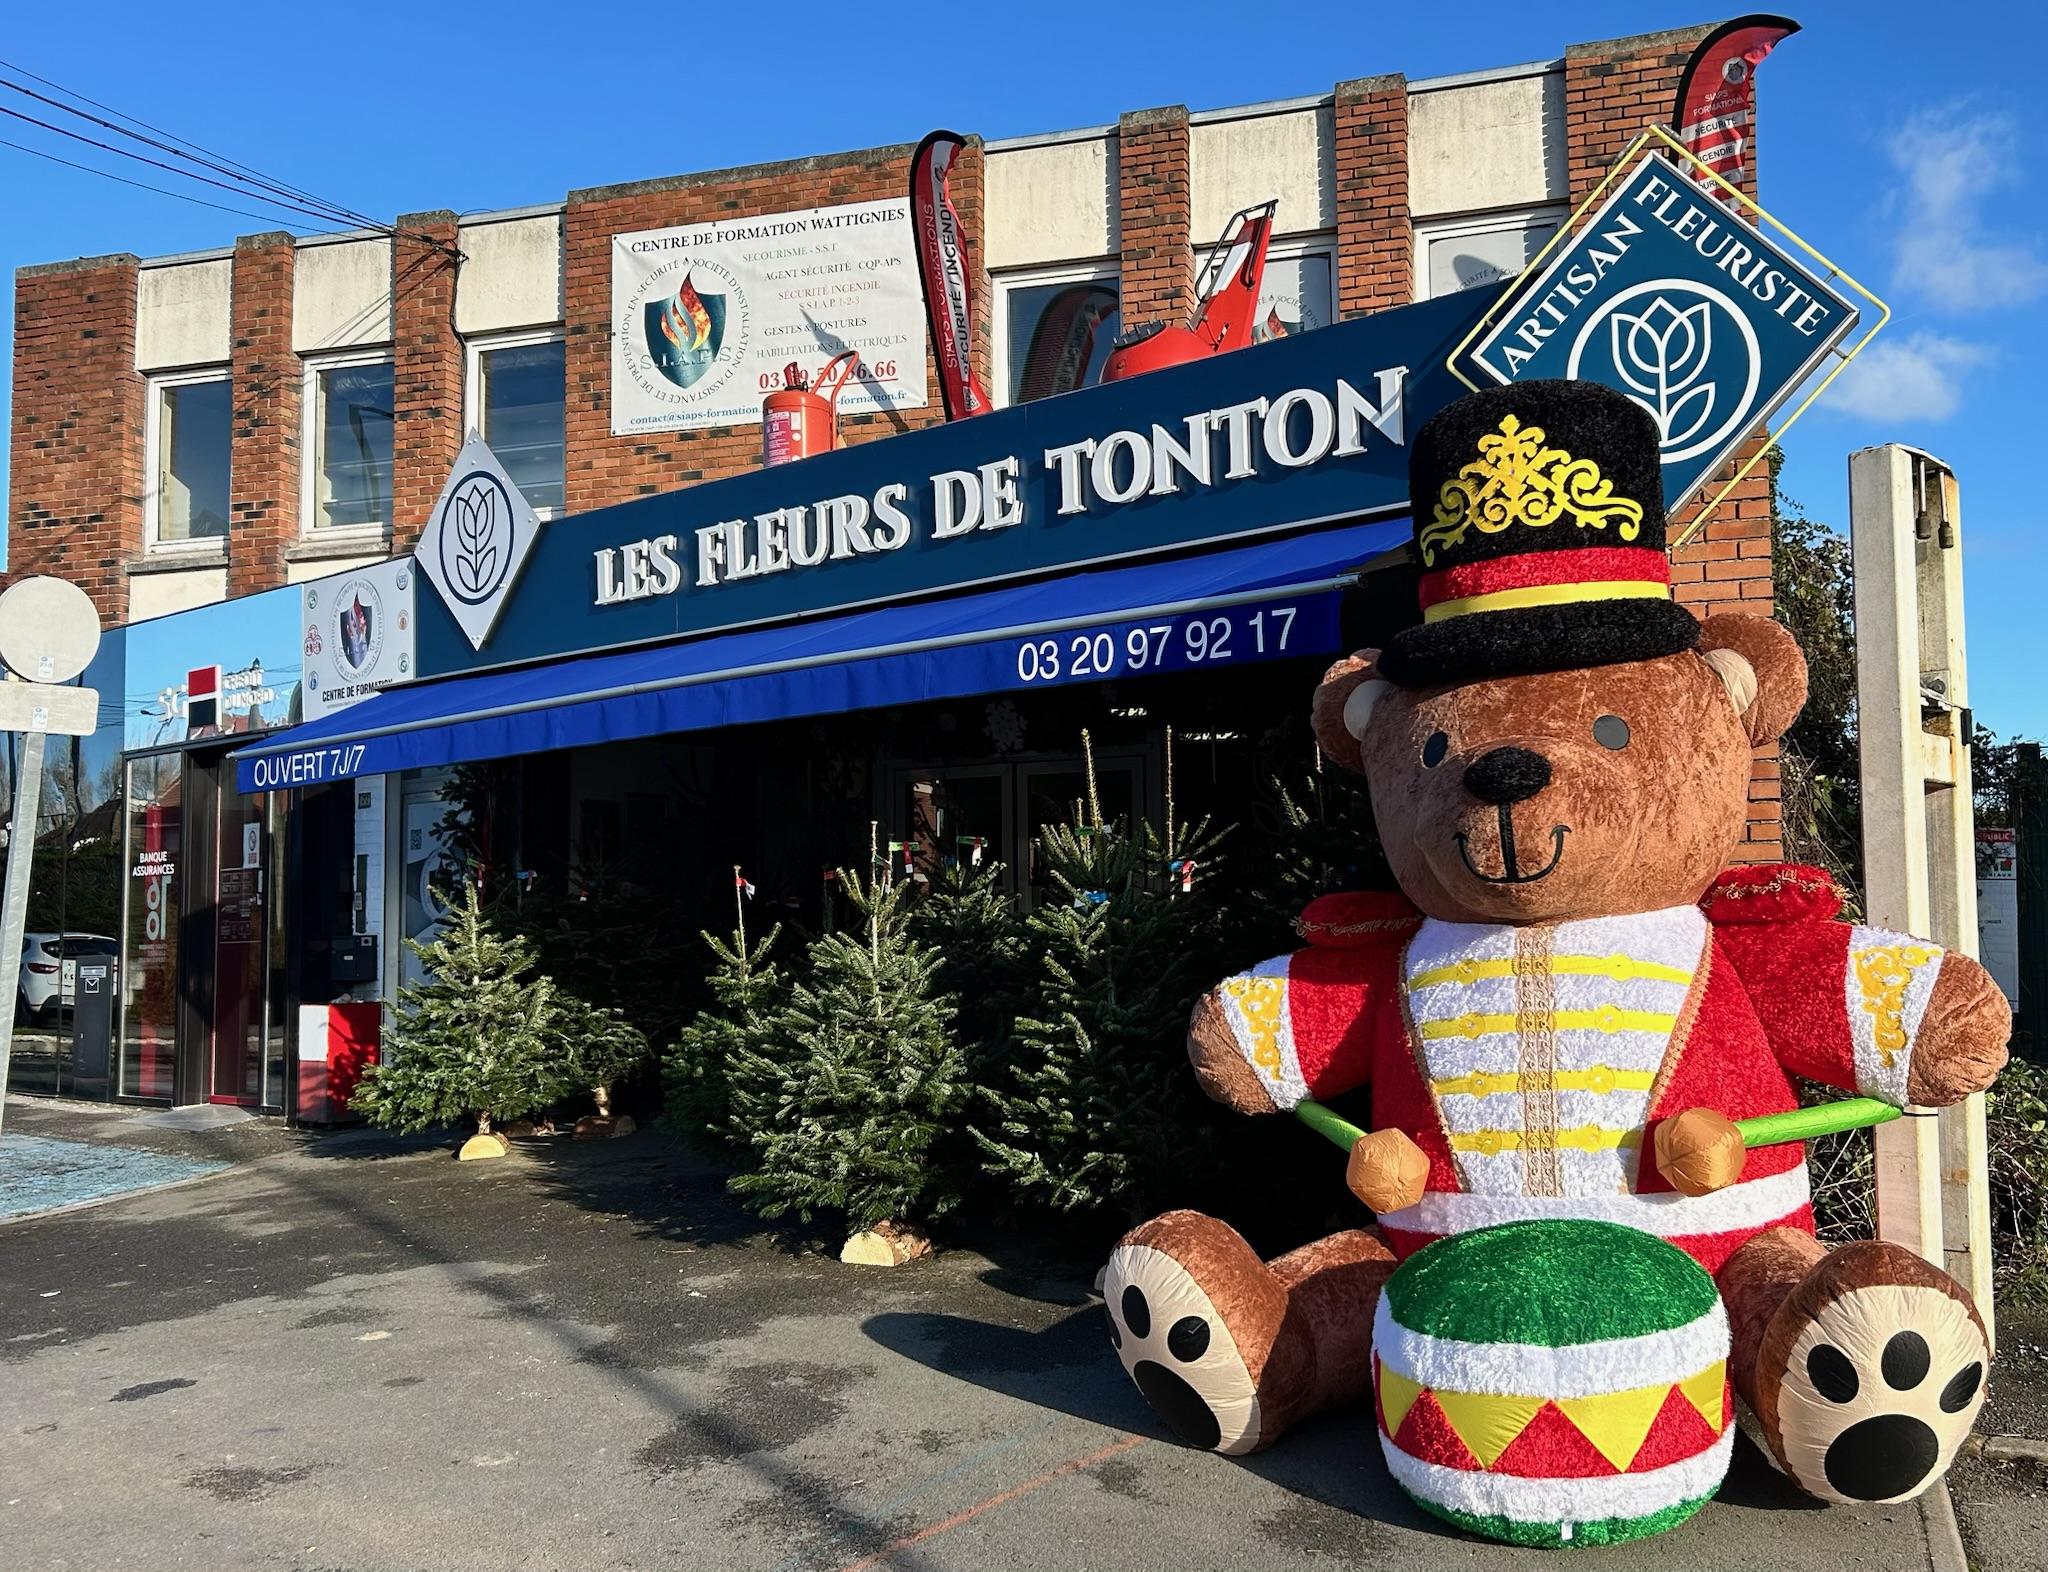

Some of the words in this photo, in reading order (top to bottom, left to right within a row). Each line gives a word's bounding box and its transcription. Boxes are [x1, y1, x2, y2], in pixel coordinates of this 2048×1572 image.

[632, 234, 691, 254] CENTRE
[693, 231, 714, 247] DE
[716, 220, 808, 244] FORMATION
[811, 208, 905, 231] WATTIGNIES
[742, 246, 808, 263] SECOURISME
[764, 269, 797, 281] AGENT
[858, 256, 902, 271] CQP-APS
[1501, 210, 1645, 377] ARTISAN
[1632, 174, 1831, 338] FLEURISTE
[831, 280, 881, 294] INCENDIE
[627, 295, 640, 311] EN
[764, 325, 801, 337] GESTES
[814, 317, 868, 331] POSTURES
[756, 340, 833, 358] HABILITATIONS
[640, 380, 654, 394] DE
[594, 535, 682, 606] LES
[695, 483, 912, 587] FLEURS
[929, 455, 1024, 540] DE
[1044, 366, 1410, 515] TONTON
[1017, 641, 1060, 682] 03
[1070, 632, 1115, 676] 20
[1126, 625, 1173, 670] 97
[1185, 616, 1232, 662] 92
[1248, 606, 1297, 652] 17
[322, 689, 345, 702] CENTRE
[346, 686, 355, 697] DE
[253, 748, 325, 787] OUVERT
[330, 744, 366, 775] 7J/7
[139, 851, 167, 863] BANQUE
[133, 864, 174, 877] ASSURANCES
